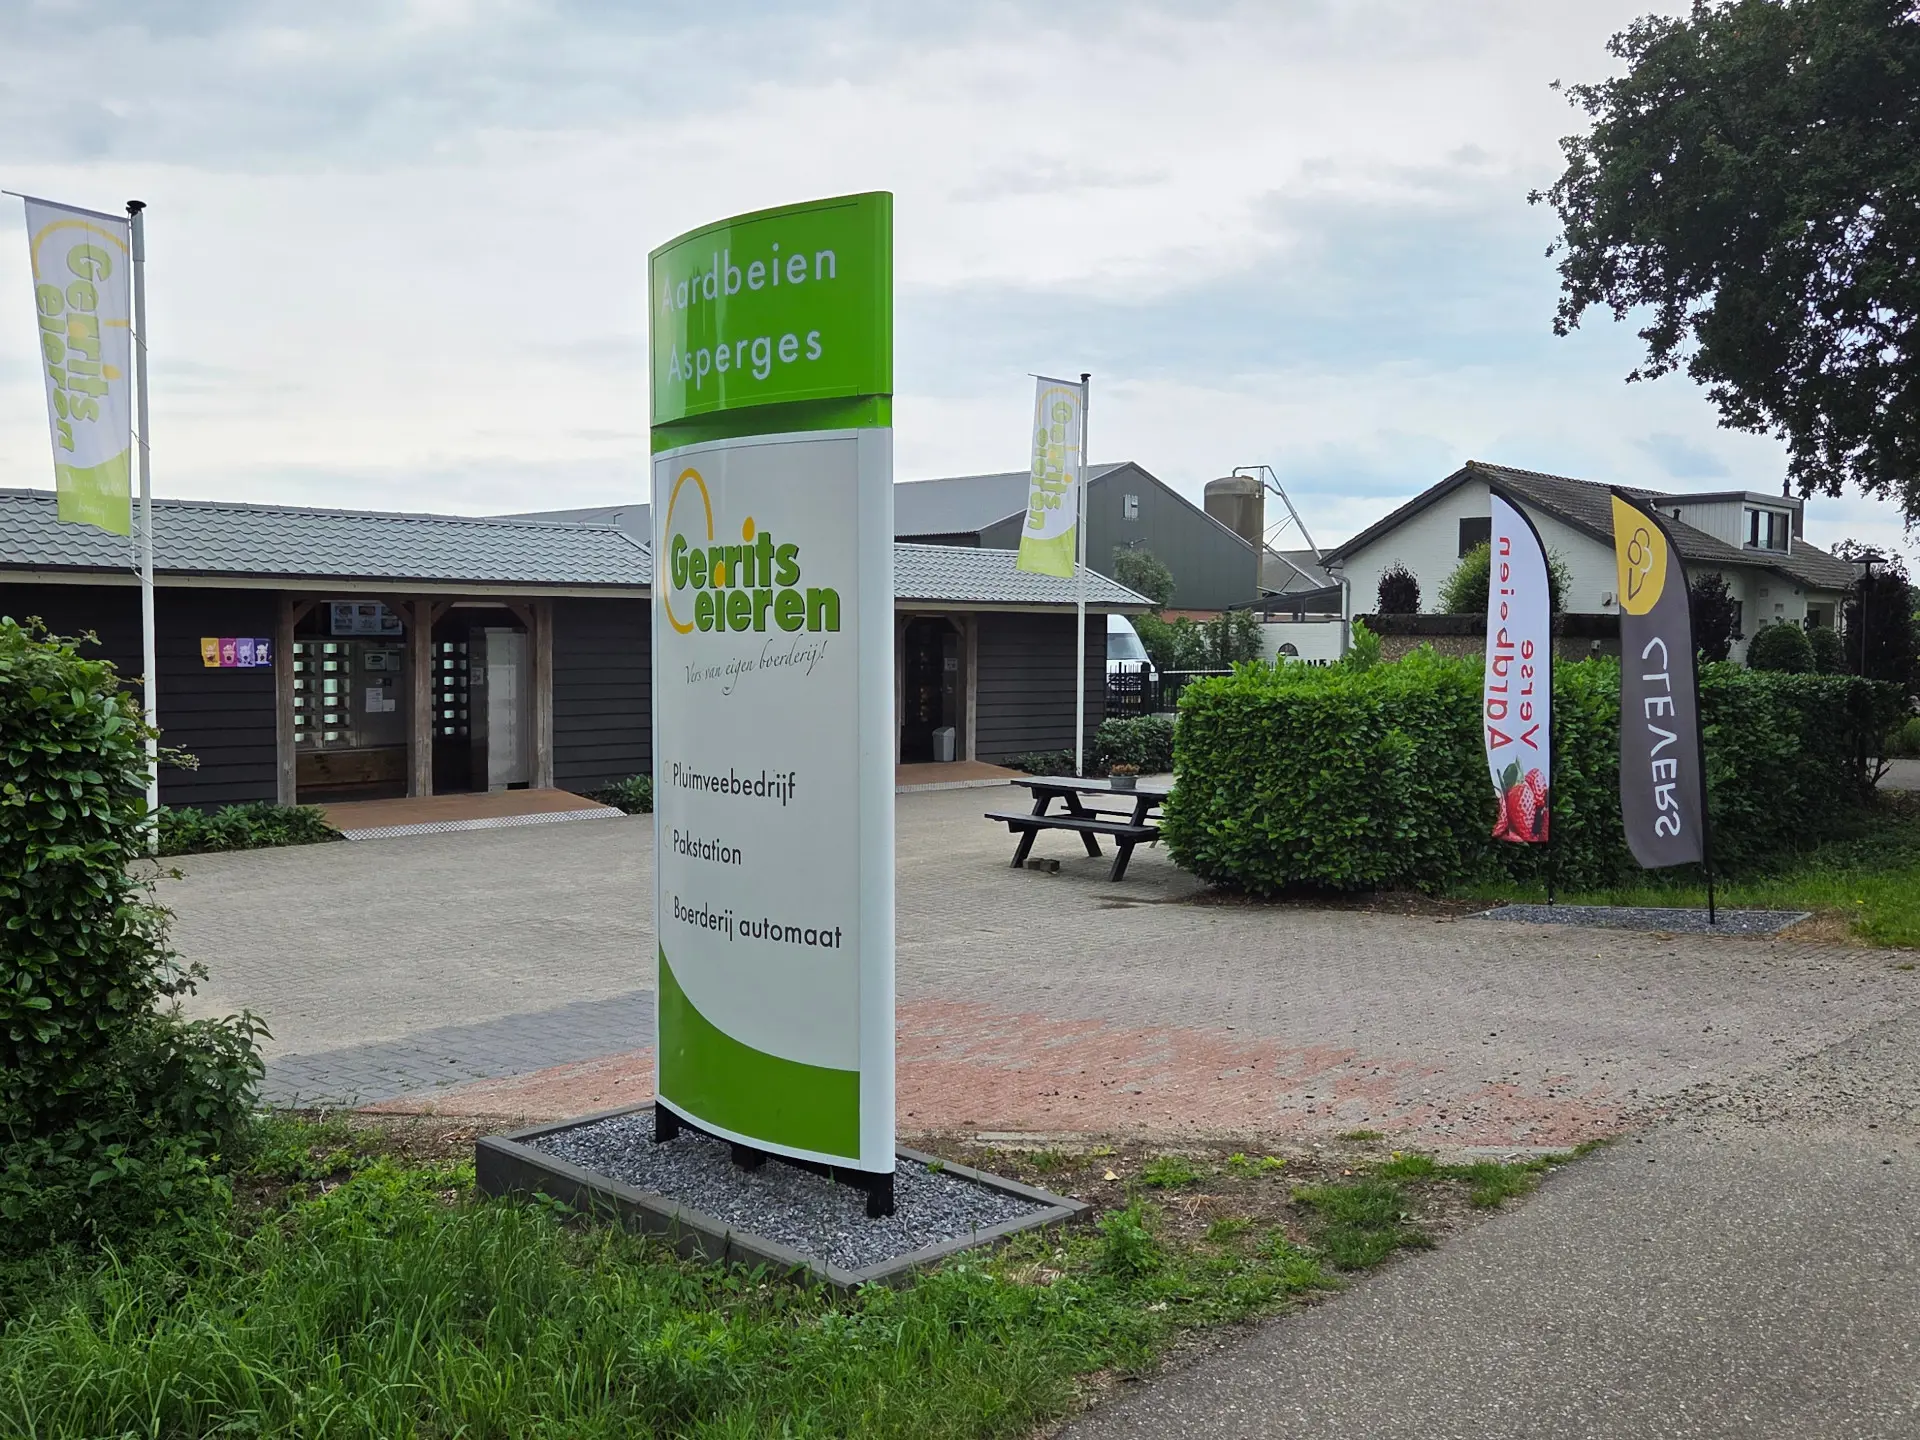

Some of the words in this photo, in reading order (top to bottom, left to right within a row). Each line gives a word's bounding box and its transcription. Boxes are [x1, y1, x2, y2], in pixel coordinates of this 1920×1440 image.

[661, 242, 836, 315] Aardbeien
[66, 243, 120, 423] Gerrits
[668, 330, 822, 391] Asperges
[1044, 401, 1073, 510] Gerrits
[671, 516, 800, 590] Gerrits
[685, 663, 701, 684] Vers
[704, 664, 723, 678] van
[722, 657, 754, 696] eigen
[759, 633, 828, 676] boerderij!
[673, 762, 796, 806] Pluimveebedrijf
[673, 829, 742, 865] Pakstation
[674, 895, 733, 941] Boerderij
[739, 918, 842, 949] automaat
